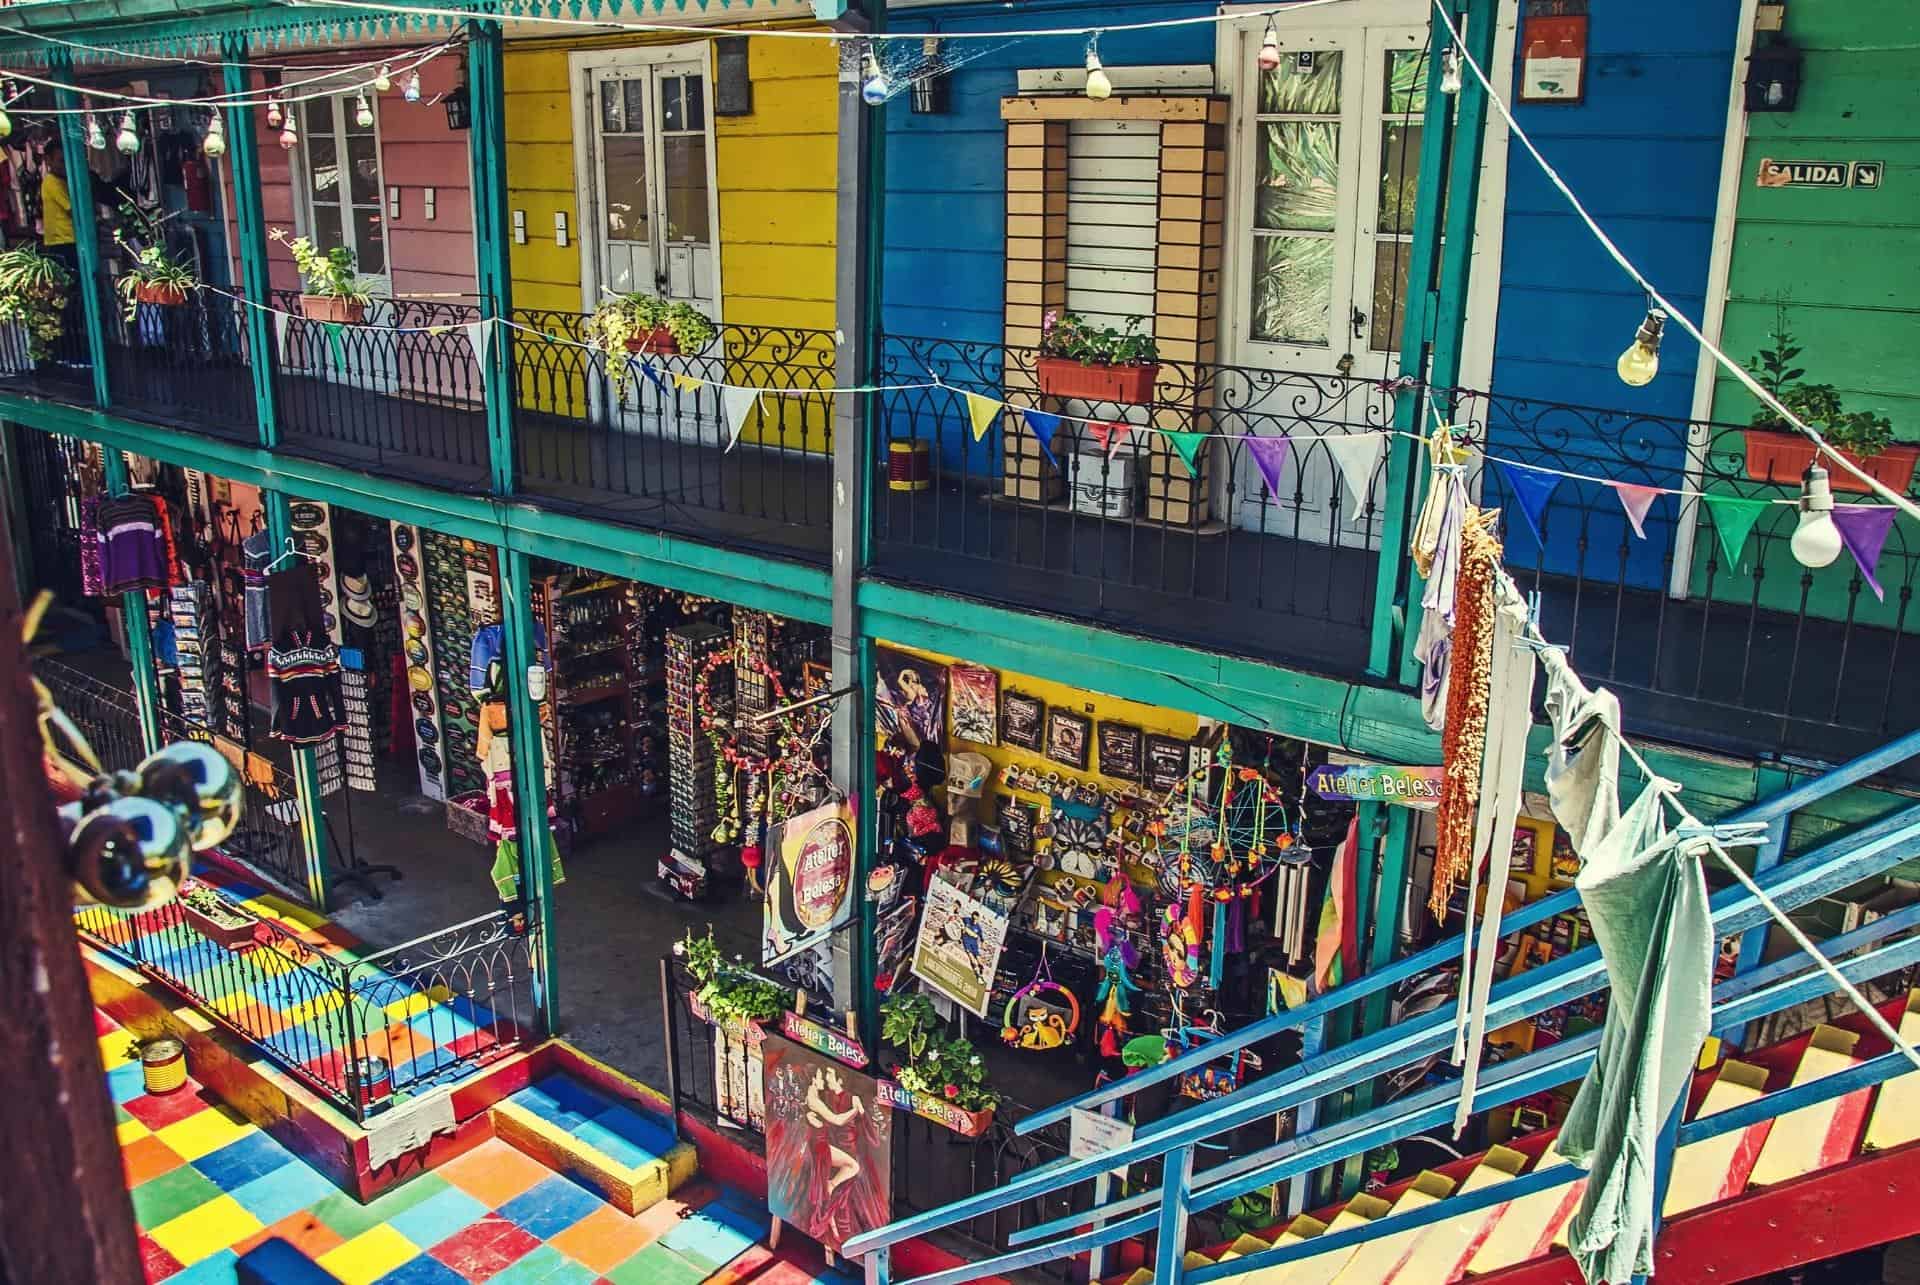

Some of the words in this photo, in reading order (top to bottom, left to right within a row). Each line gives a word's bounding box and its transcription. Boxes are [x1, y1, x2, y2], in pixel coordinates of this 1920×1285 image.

[1767, 165, 1840, 183] SALIDA
[1317, 773, 1377, 795] Atelier
[804, 840, 845, 872] Atelier
[803, 874, 841, 904] Belesa
[787, 1016, 825, 1047] Atelier
